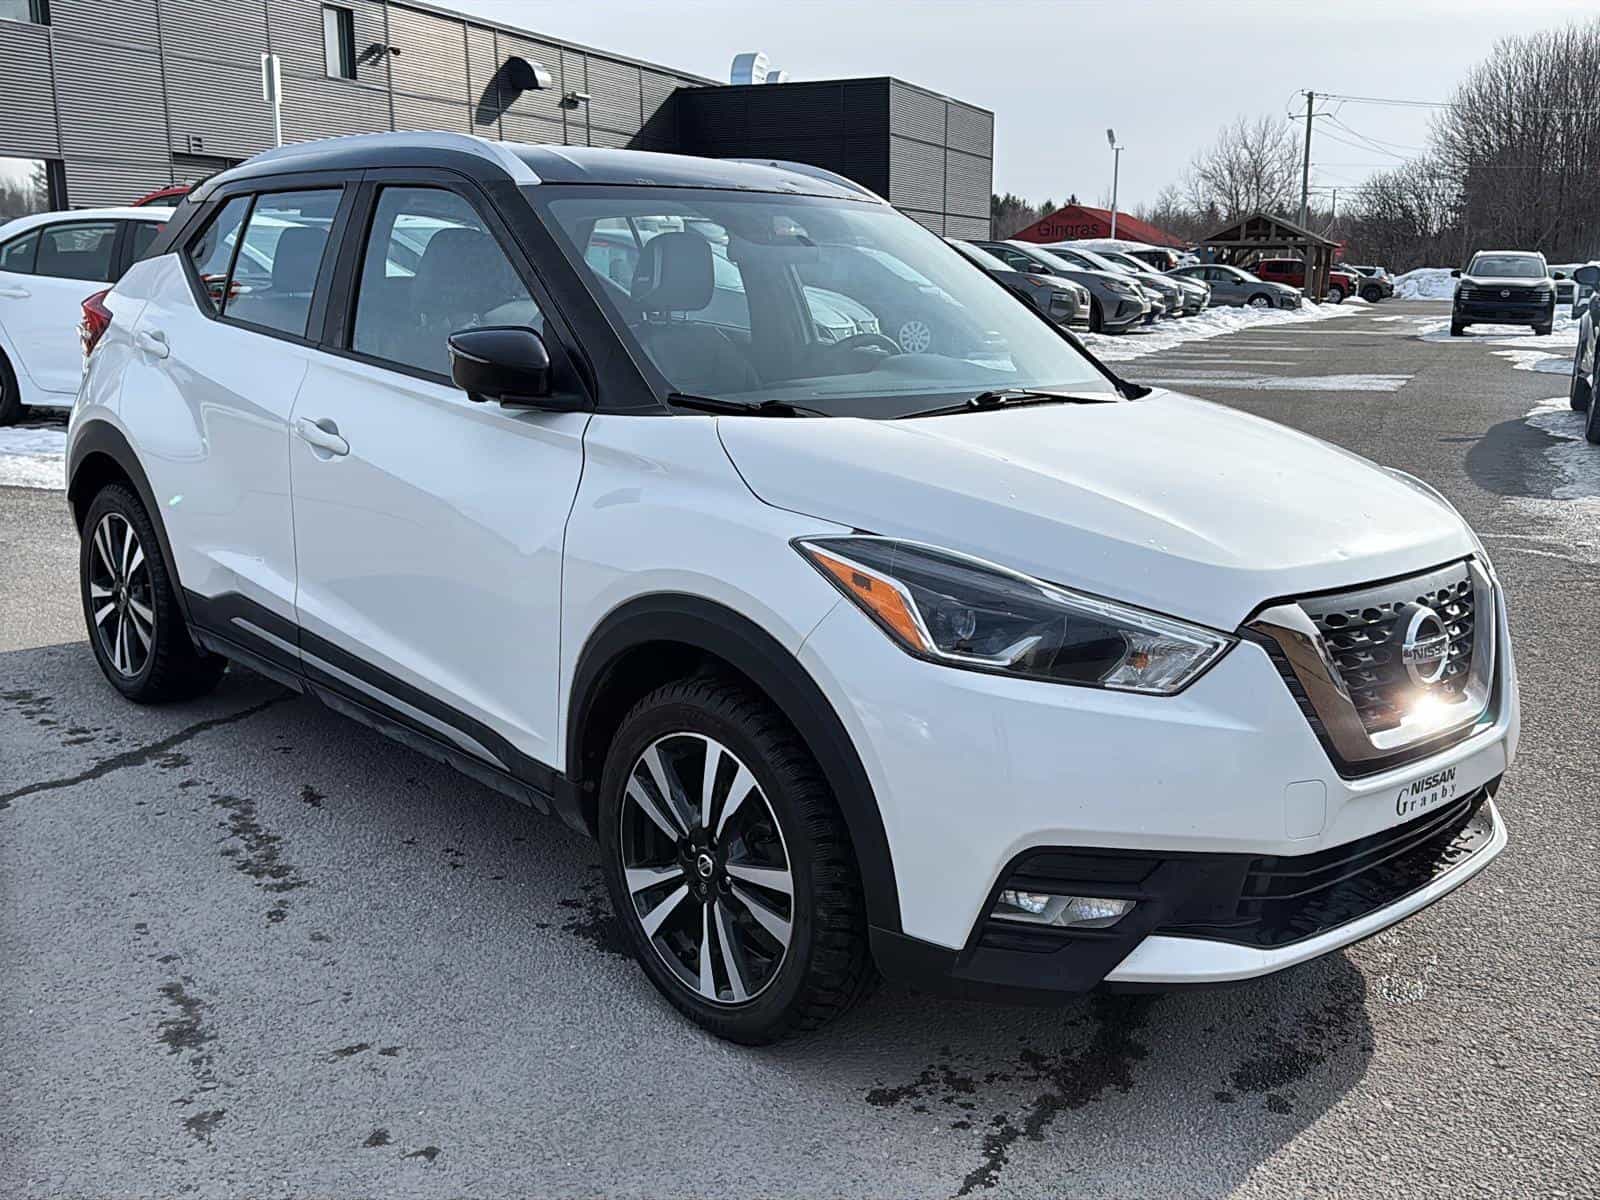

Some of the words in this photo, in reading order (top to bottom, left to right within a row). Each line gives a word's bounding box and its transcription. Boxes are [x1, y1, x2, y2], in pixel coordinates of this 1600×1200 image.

[1039, 222, 1098, 239] Gingras
[1411, 767, 1456, 796] NISSAN
[1396, 784, 1456, 816] Granby
